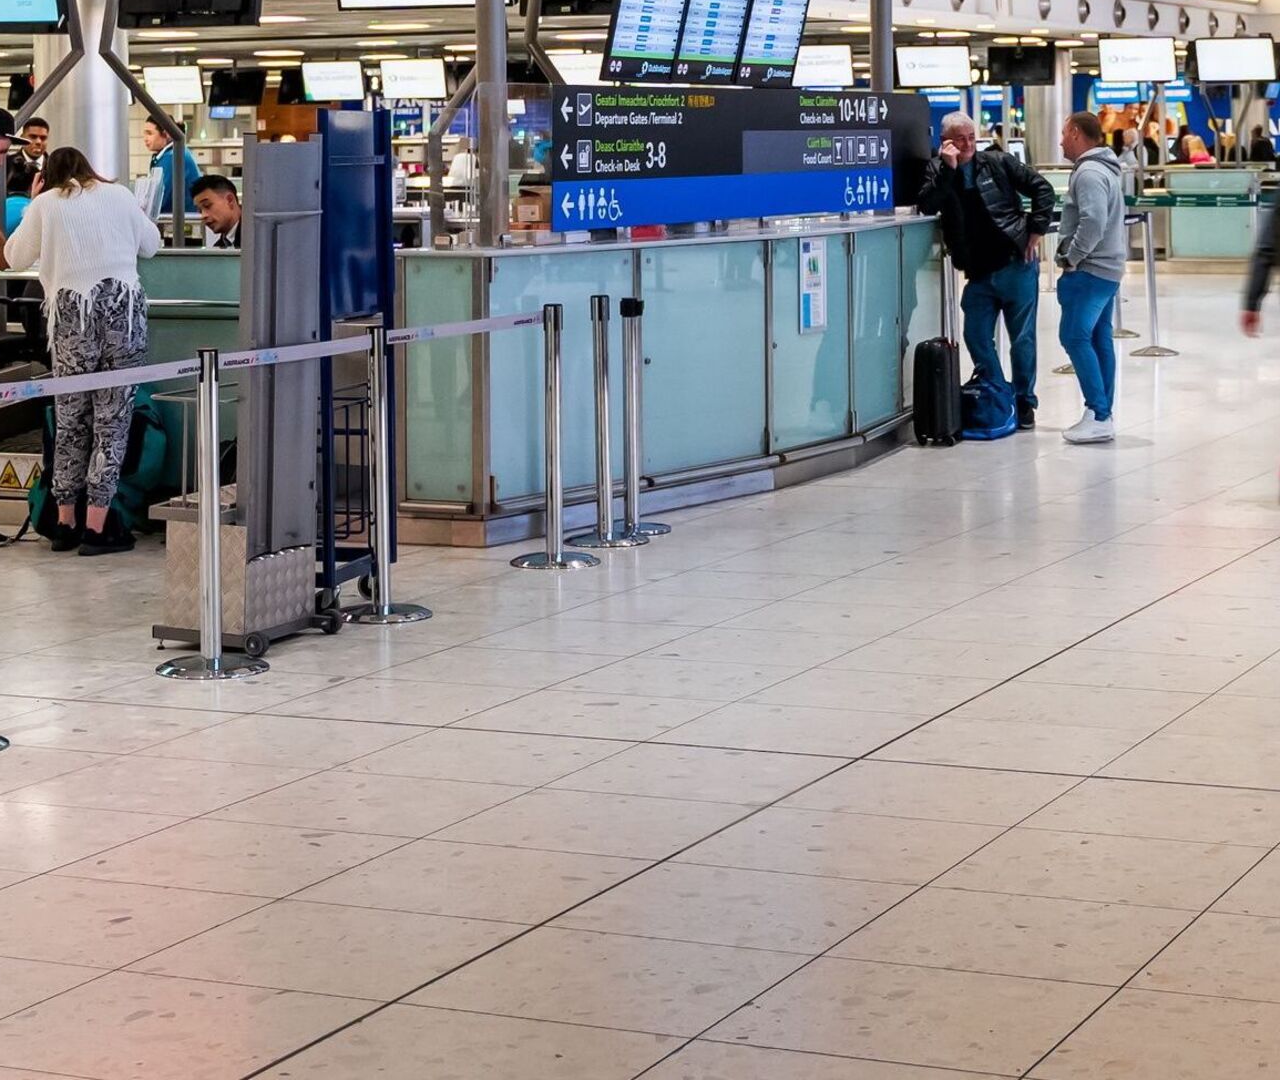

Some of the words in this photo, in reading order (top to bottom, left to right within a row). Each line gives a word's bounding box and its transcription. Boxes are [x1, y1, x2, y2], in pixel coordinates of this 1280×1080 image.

[799, 96, 816, 107] Deasc
[838, 98, 866, 123] 10-14
[595, 112, 628, 128] Departure
[629, 112, 648, 124] Gates
[799, 112, 822, 125] Check-in
[822, 112, 835, 124] Desk
[595, 140, 615, 152] Deasc
[645, 141, 667, 169] 3-8
[803, 153, 817, 165] Food
[817, 153, 832, 164] Court
[595, 160, 624, 173] Check-in
[624, 159, 641, 171] Desk
